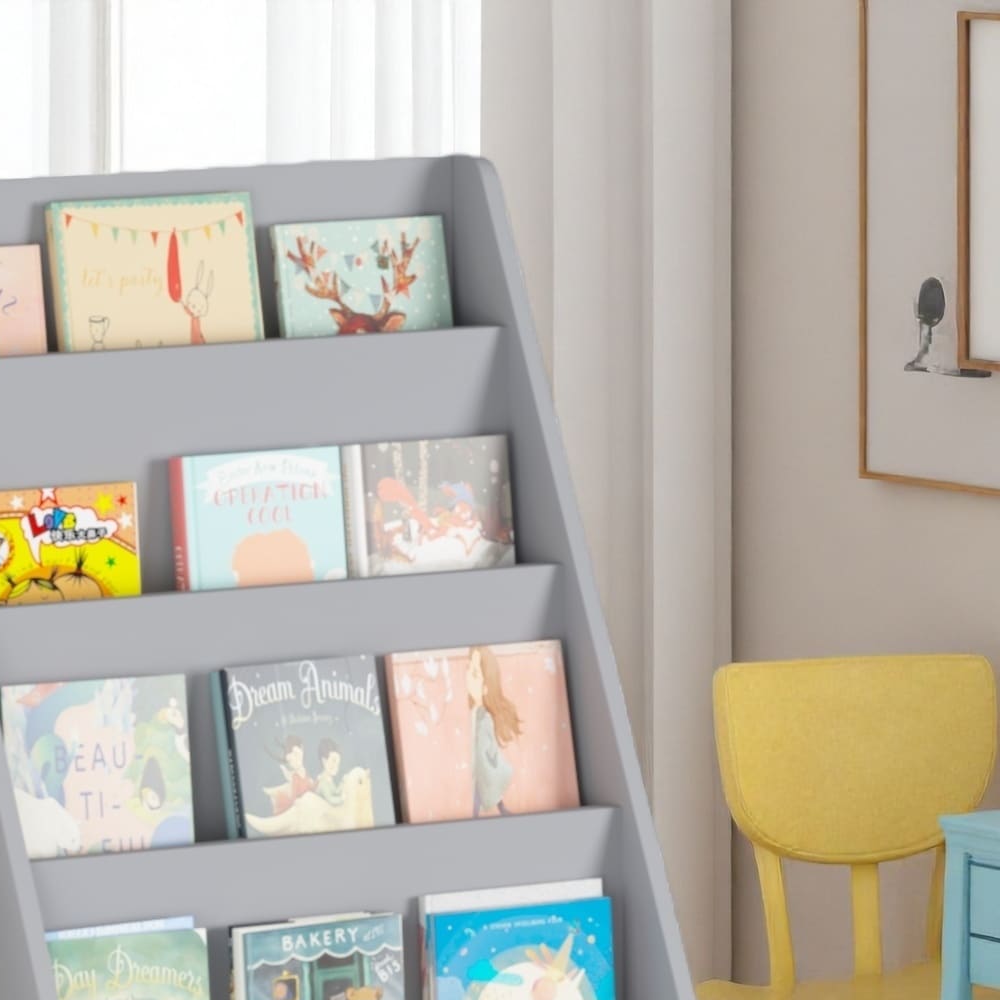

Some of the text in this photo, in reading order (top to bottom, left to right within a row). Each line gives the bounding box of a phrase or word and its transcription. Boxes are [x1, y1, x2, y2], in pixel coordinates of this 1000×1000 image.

[227, 660, 381, 731] Dream Animals
[281, 927, 358, 951] BAKERY
[105, 944, 203, 998] Dreamers
